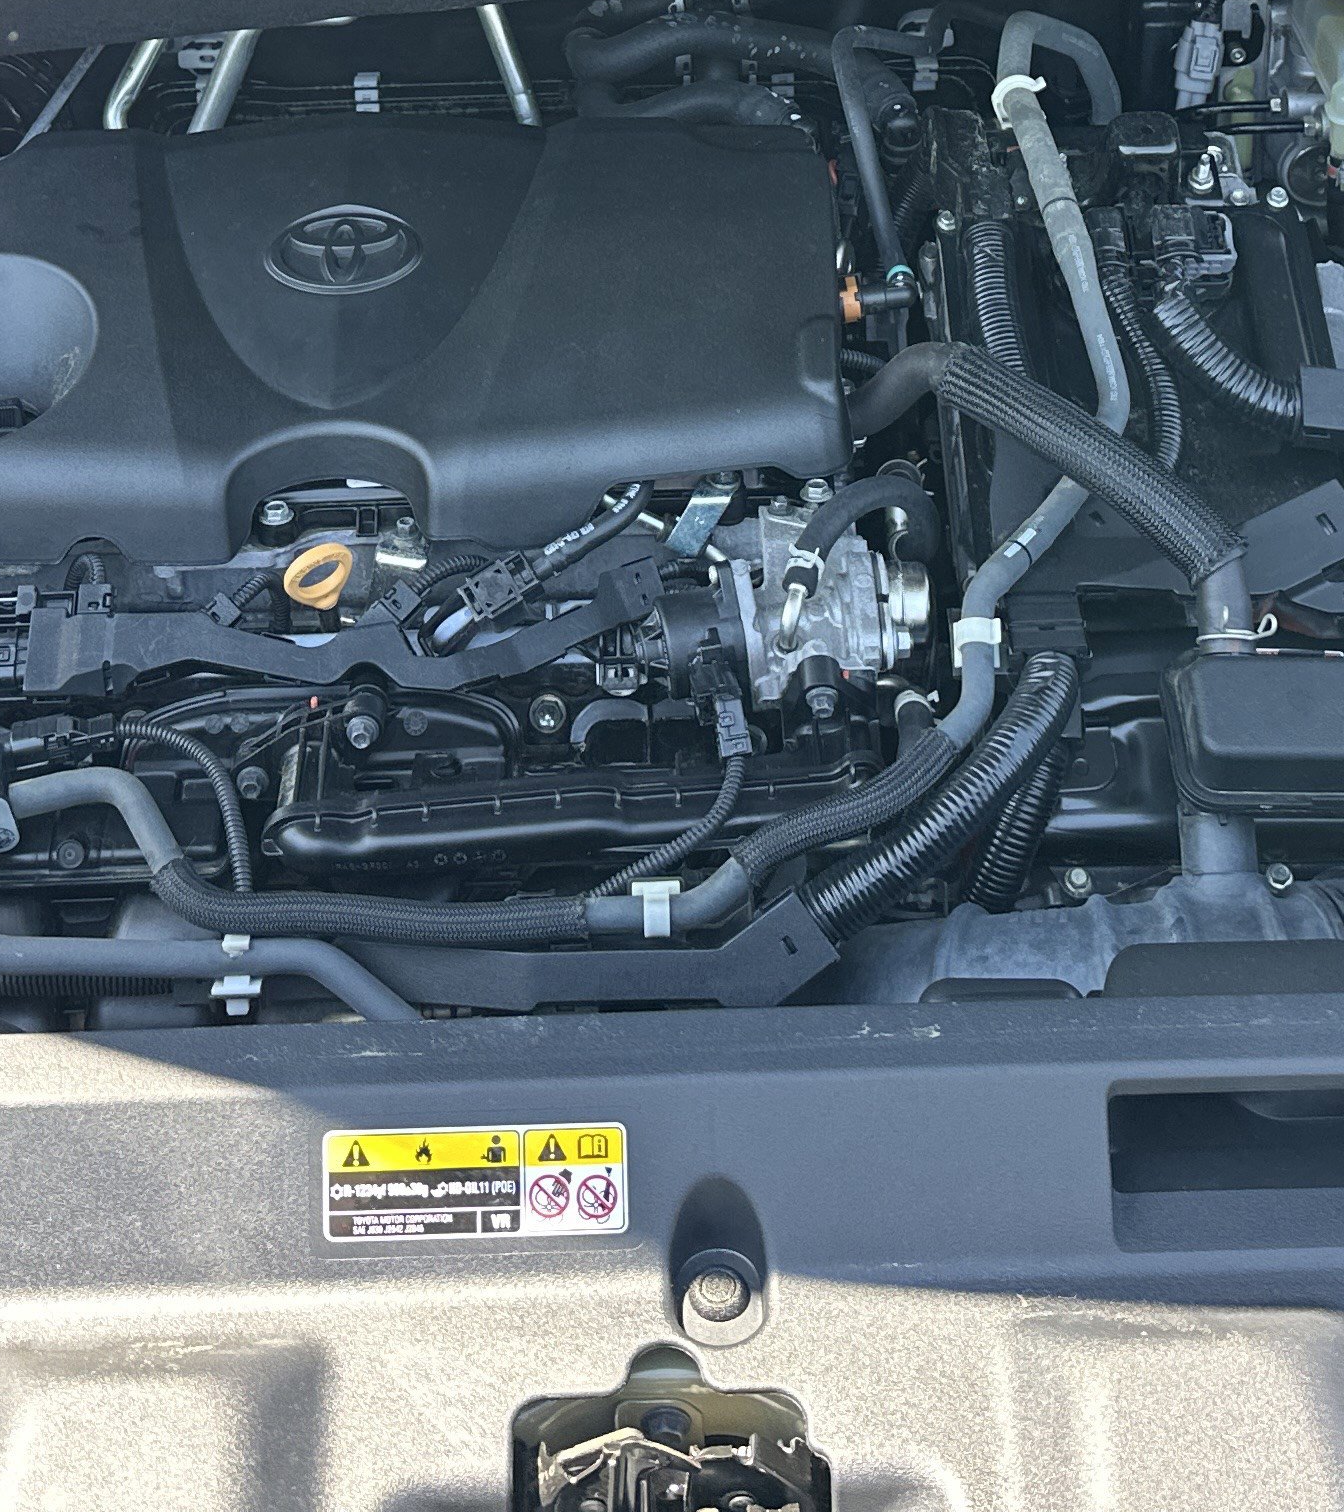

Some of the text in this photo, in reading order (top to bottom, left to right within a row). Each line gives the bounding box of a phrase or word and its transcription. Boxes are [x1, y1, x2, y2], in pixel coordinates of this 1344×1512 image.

[491, 1180, 516, 1195] (POE)
[352, 1216, 379, 1225] TOYOTA
[490, 1213, 511, 1229] VR
